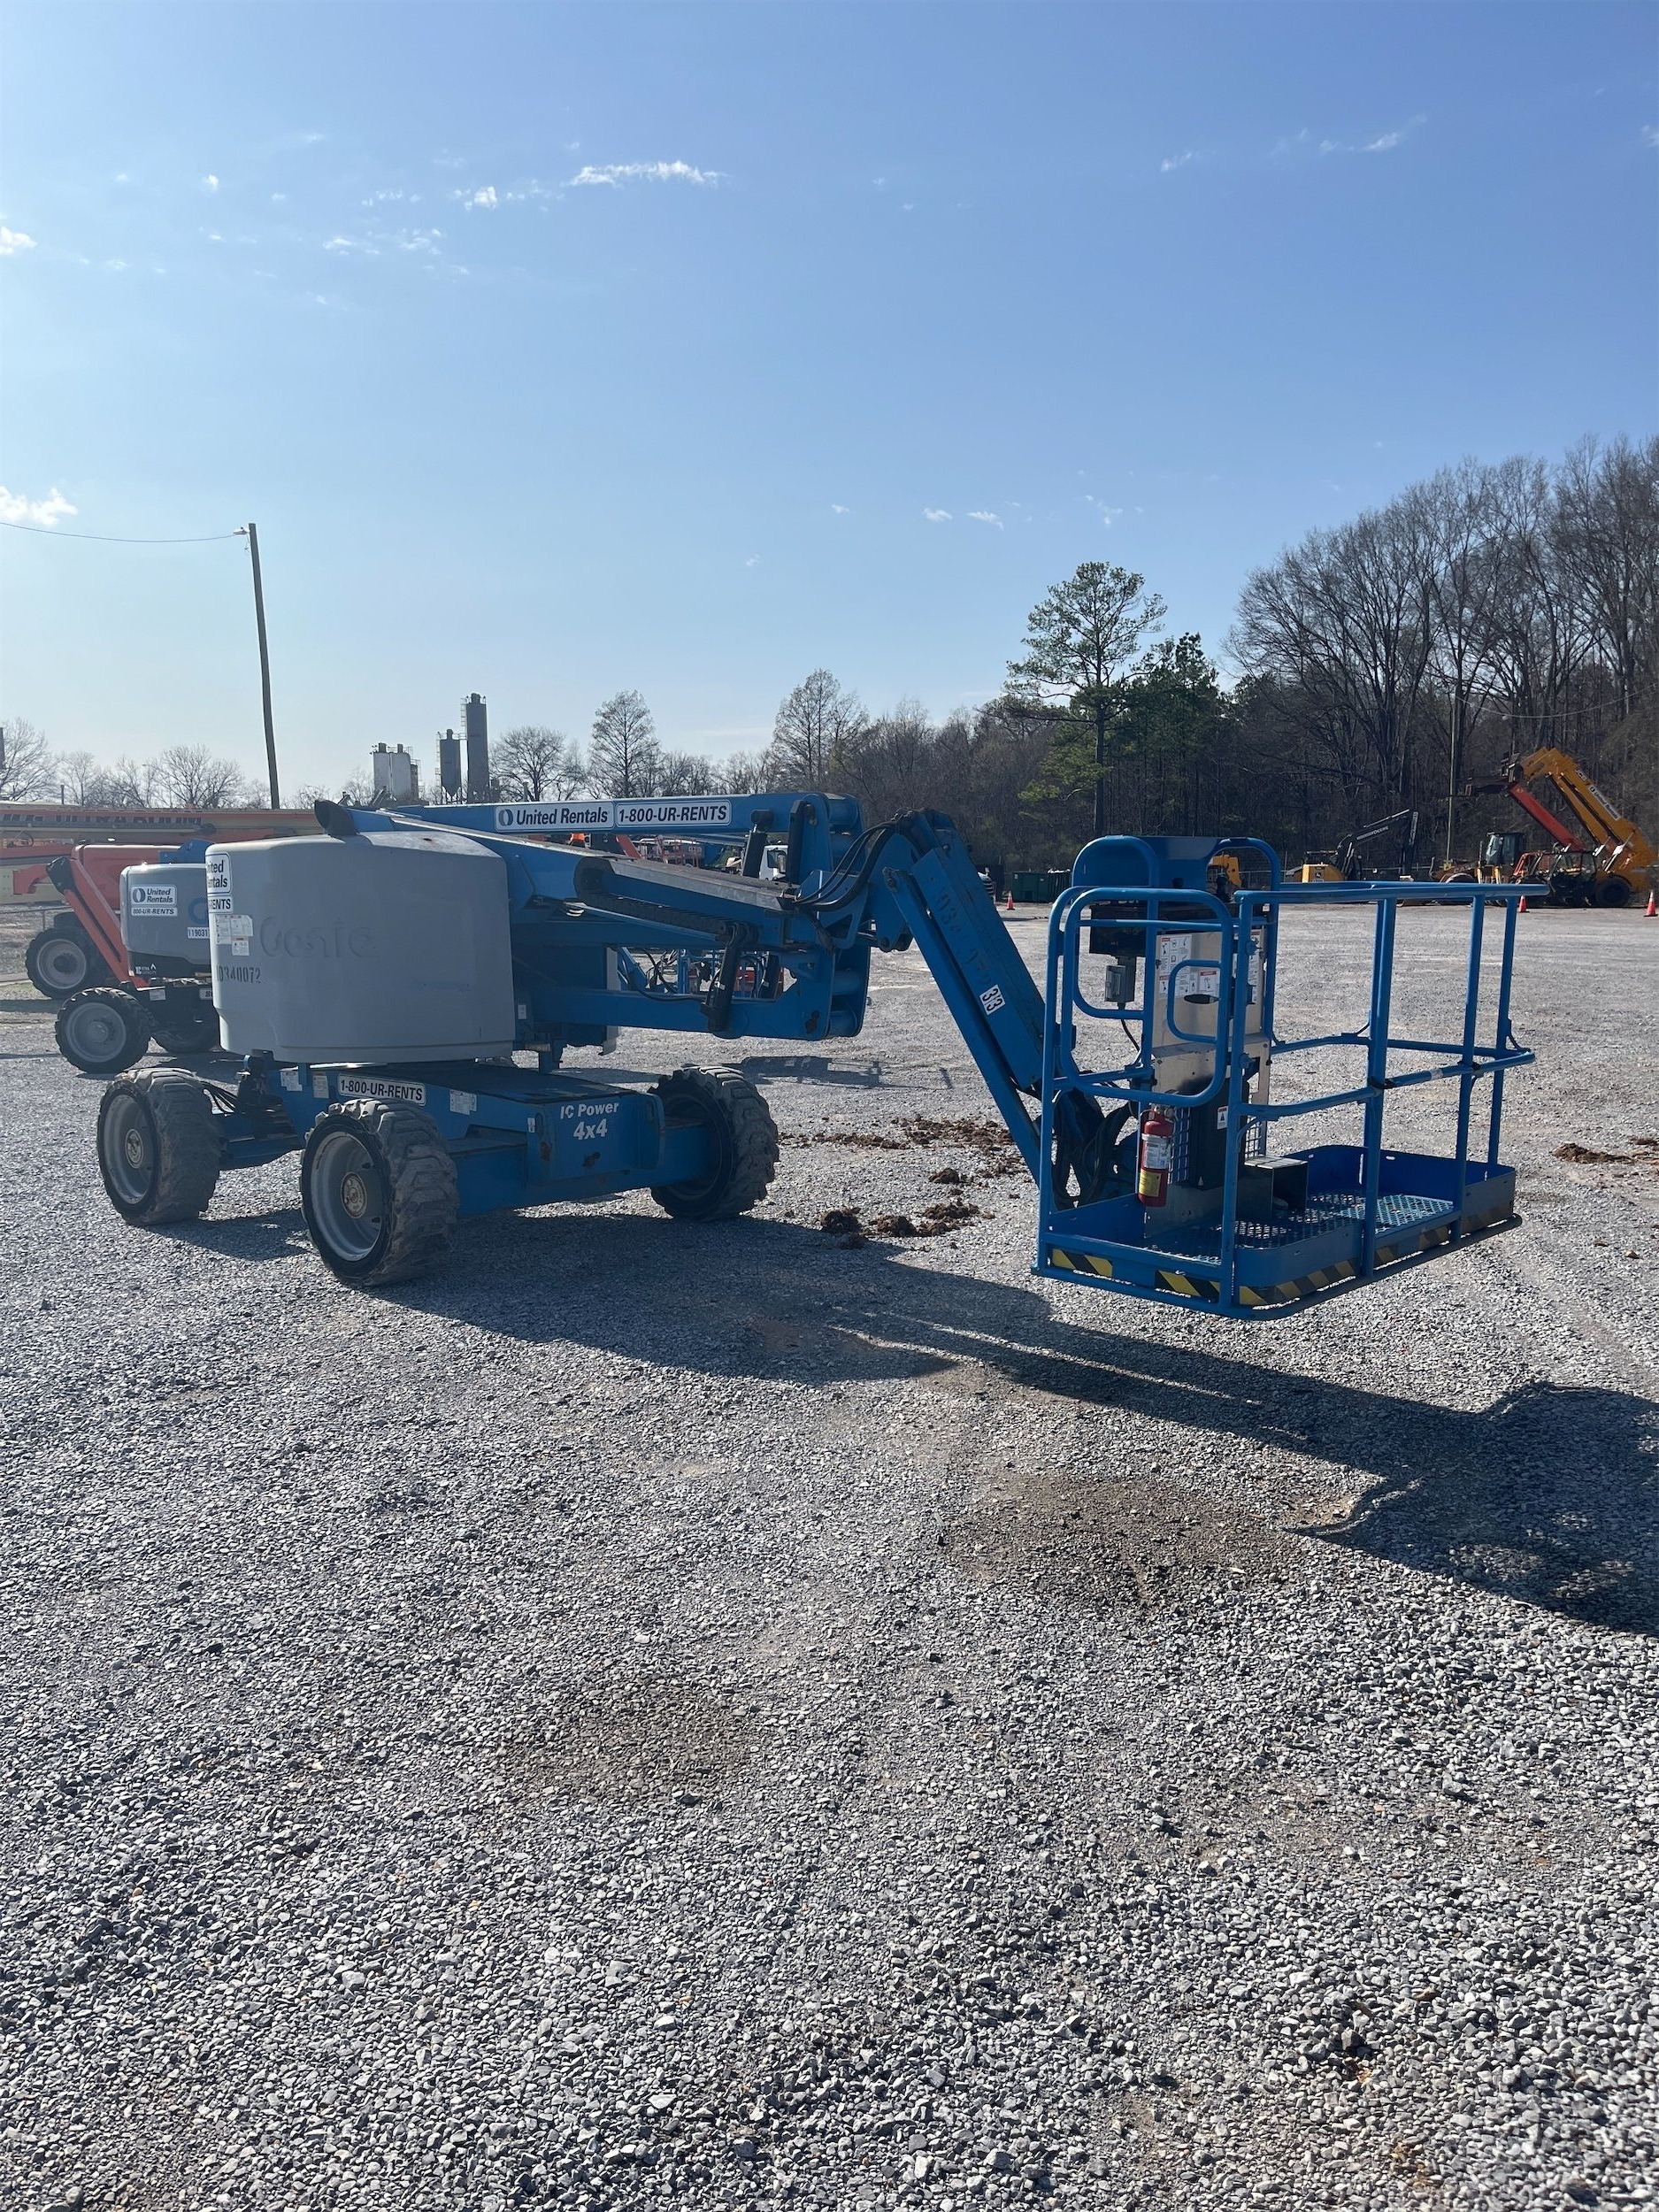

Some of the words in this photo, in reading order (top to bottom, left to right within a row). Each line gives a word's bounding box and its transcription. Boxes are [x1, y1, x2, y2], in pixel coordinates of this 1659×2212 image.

[516, 809, 557, 826] United
[561, 806, 609, 825] Rentals
[619, 805, 727, 823] 1-800-UR-RENTS
[188, 928, 210, 937] 119031
[259, 915, 379, 958] Genie
[341, 1079, 423, 1101] 1-800-UR-RENTS
[560, 1104, 574, 1119] IC
[578, 1102, 619, 1118] Power
[573, 1118, 608, 1141] 4x4
